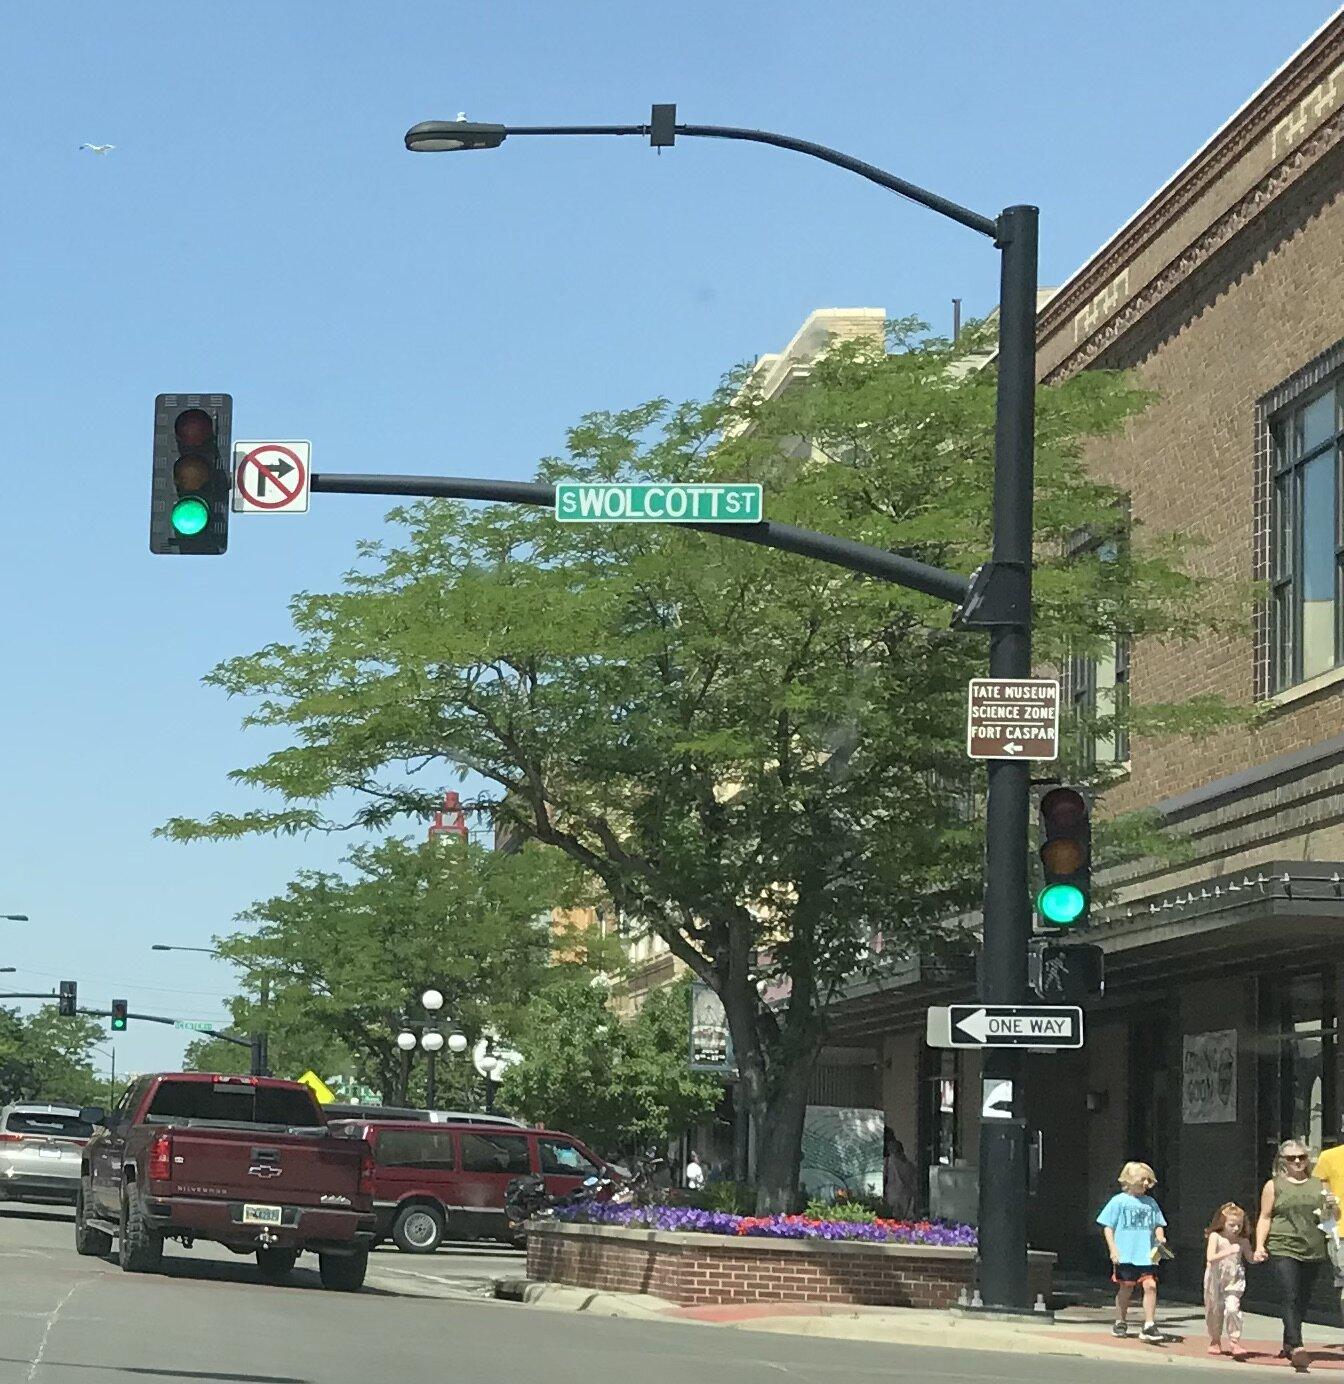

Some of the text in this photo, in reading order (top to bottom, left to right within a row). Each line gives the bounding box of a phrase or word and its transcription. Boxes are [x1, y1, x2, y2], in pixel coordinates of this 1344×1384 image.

[579, 488, 725, 518] WOLCOTT
[725, 491, 756, 514] ST
[972, 686, 1056, 699] TATE MUSEUM
[972, 706, 1055, 720] SCIENCE ZONE
[971, 727, 1056, 740] FORT CASPAR
[988, 1019, 1066, 1035] ONE WAY
